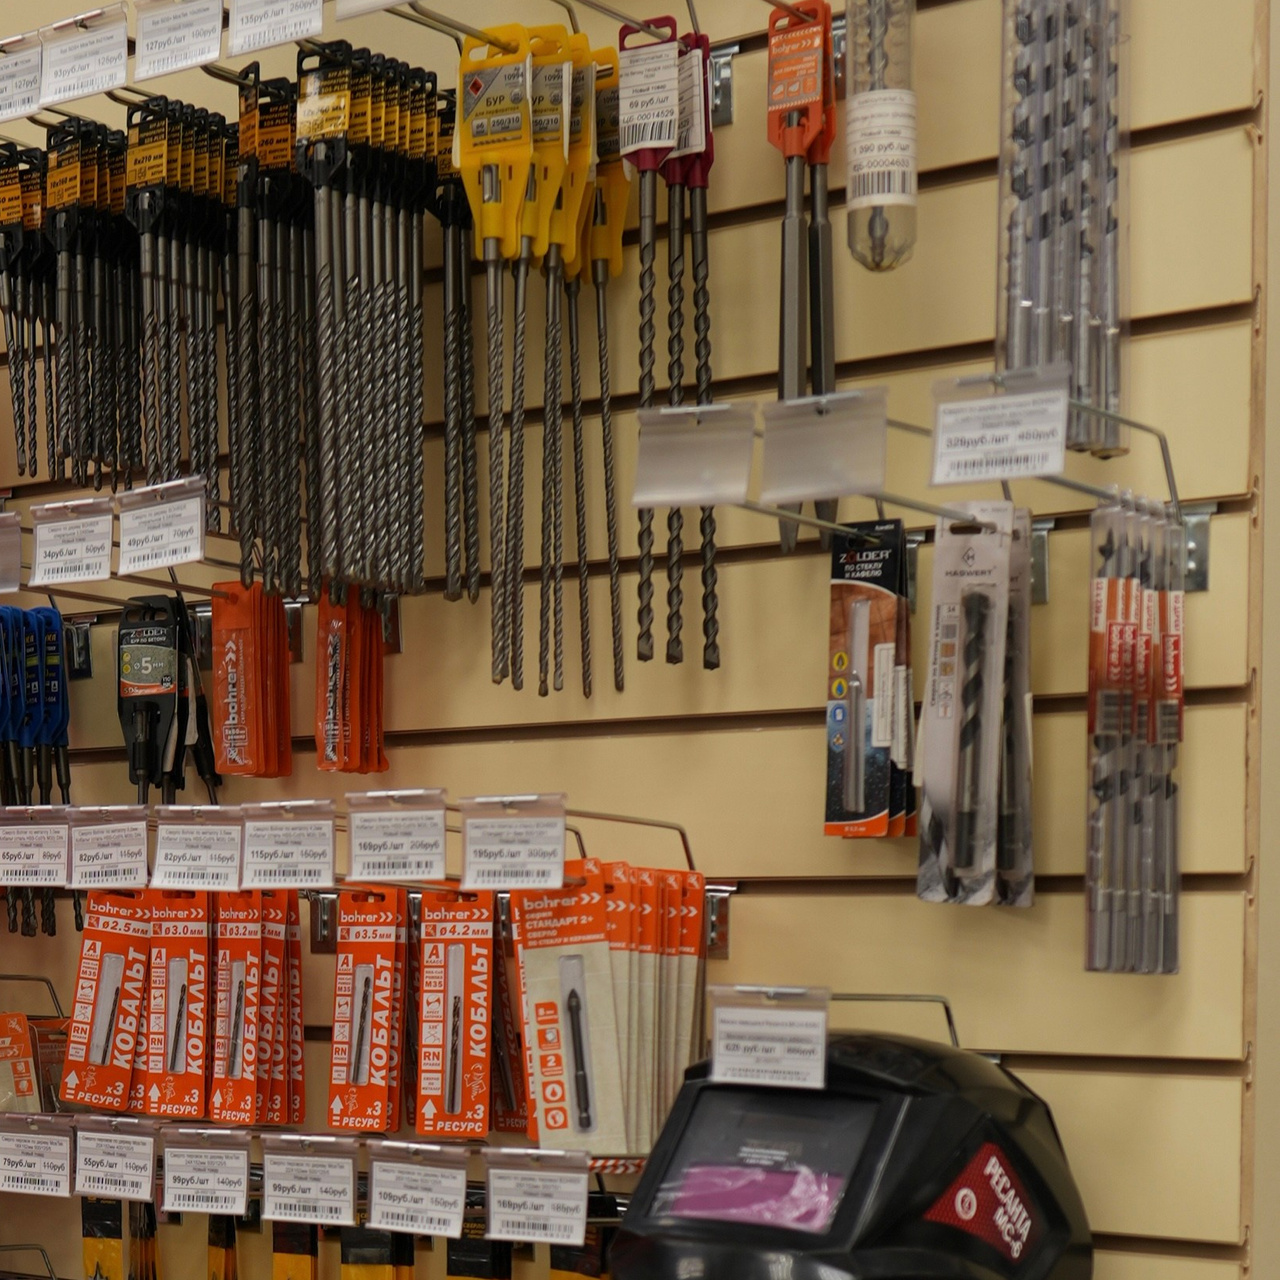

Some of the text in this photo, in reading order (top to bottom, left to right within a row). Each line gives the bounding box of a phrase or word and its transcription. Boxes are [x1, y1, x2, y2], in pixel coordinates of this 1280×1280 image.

[772, 42, 800, 55] bohrer
[632, 83, 666, 94] Новый товар
[486, 96, 505, 107] БУР
[492, 117, 520, 127] 250/310
[128, 535, 163, 547] 49руб./шт
[43, 548, 77, 558] 34руб./шт
[839, 550, 889, 563] ZOLDER
[855, 562, 883, 571] СТЕКЛУ
[851, 570, 883, 578] КАФЕЛЮ
[130, 629, 168, 638] ZOLDER
[225, 664, 238, 725] bohrer
[358, 840, 405, 853] 169руб./шт
[2, 852, 34, 861] 65руб./шт
[79, 852, 113, 862] 82руб./шт
[163, 851, 202, 863] 82руб./шт
[250, 849, 294, 861] 115руб./шт
[90, 900, 133, 917] bohrer
[523, 896, 578, 911] bohrer
[152, 907, 189, 919] bohrer
[220, 907, 248, 919] bohrer
[341, 912, 379, 923] bohrer
[425, 908, 470, 920] bohrer
[525, 915, 594, 930] СТАНДАРТ 2+
[81, 970, 97, 978] M35
[152, 978, 165, 986] M35
[424, 980, 443, 988] M35
[470, 943, 489, 1058] КОБАЛЬТ
[113, 947, 147, 1070] КОБАЛЬТ
[187, 949, 205, 1076] КОБАЛЬТ
[242, 951, 259, 1081] КОБАЛЬТ
[370, 954, 393, 1086] КОБАЛЬТ
[72, 1025, 88, 1036] RN
[150, 1037, 163, 1046] RN
[216, 1041, 227, 1051] RN
[334, 1046, 347, 1056] RN
[423, 1051, 440, 1062] RN
[77, 1091, 121, 1107] РЕСУРС
[160, 1104, 198, 1115] РЕСУРС
[221, 1111, 251, 1123] РЕСУРС
[342, 1117, 380, 1128] РЕСУРС
[436, 1121, 483, 1132] РЕСУРС
[3, 1157, 36, 1169] 79руб./шт
[83, 1156, 118, 1169] 55руб./шт
[172, 1175, 210, 1187] 99руб./шт
[272, 1183, 312, 1196] 99руб./шт
[378, 1191, 424, 1205] 109руб./шт
[983, 1155, 1032, 1243] РЕСАНТА
